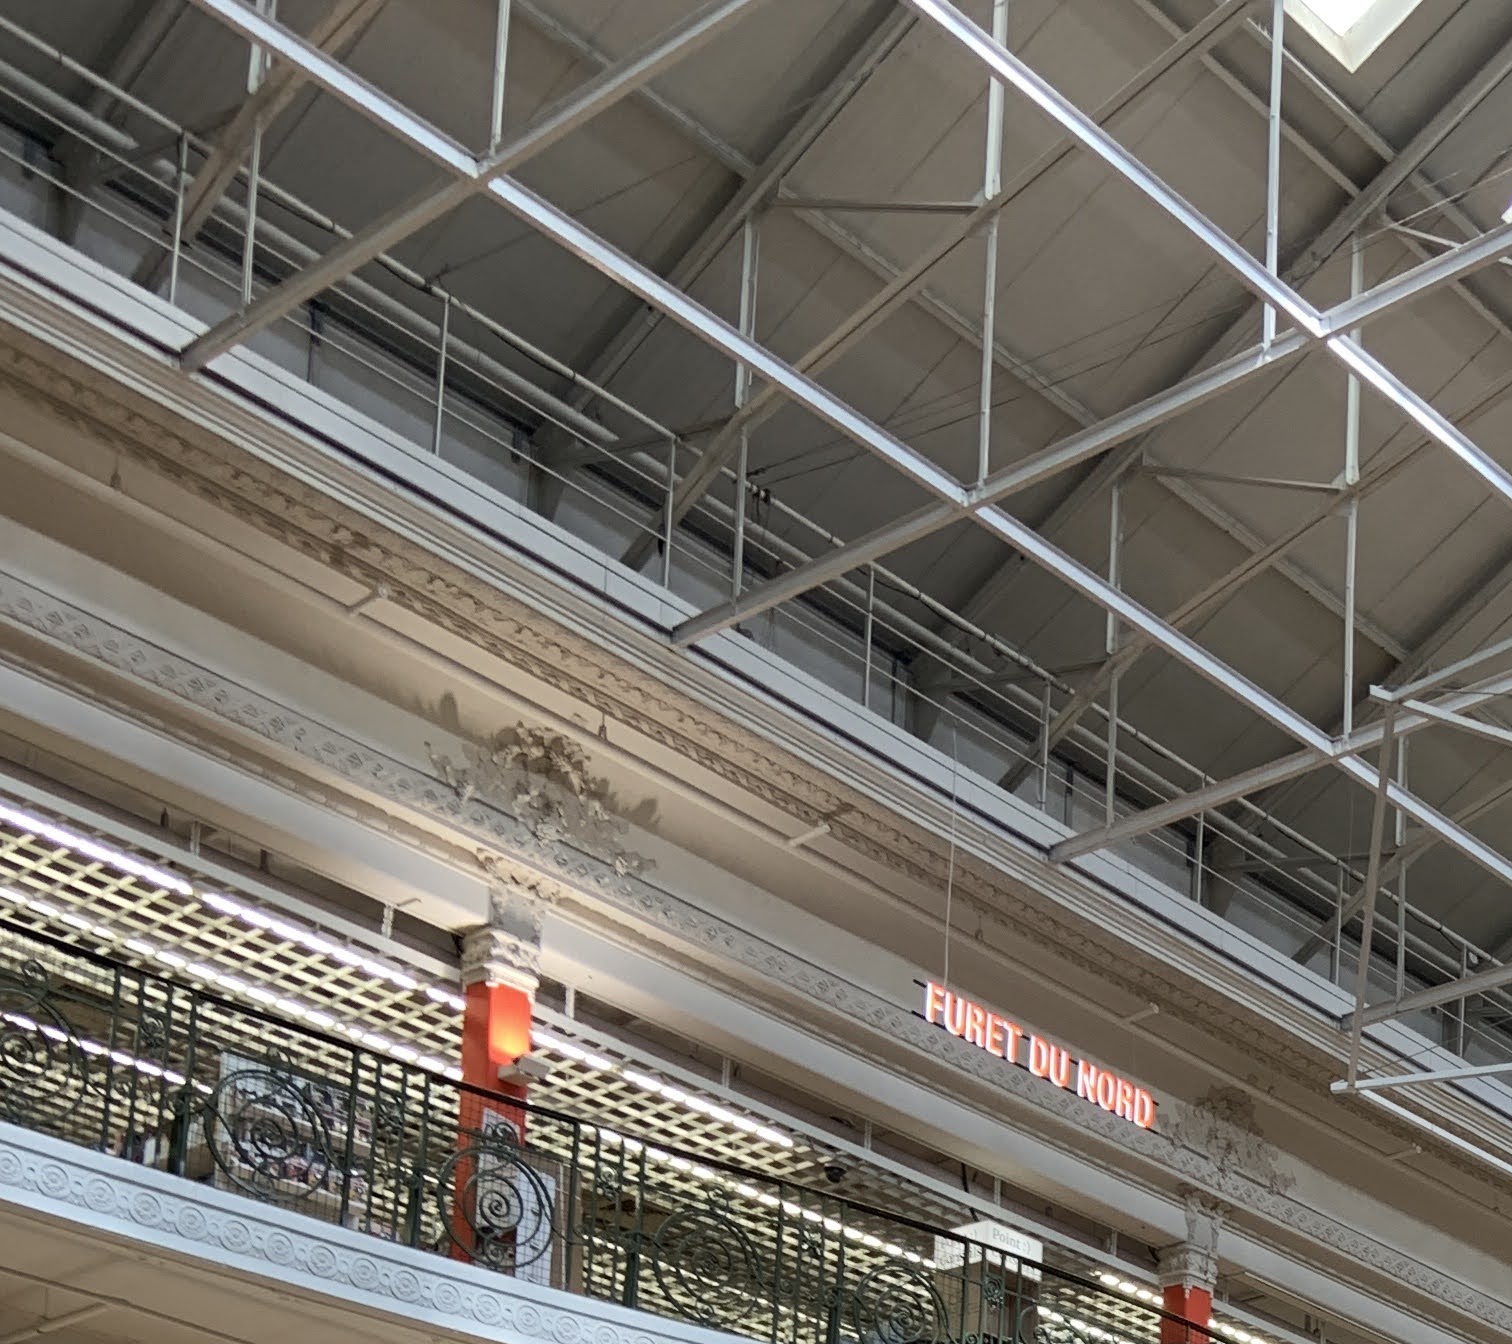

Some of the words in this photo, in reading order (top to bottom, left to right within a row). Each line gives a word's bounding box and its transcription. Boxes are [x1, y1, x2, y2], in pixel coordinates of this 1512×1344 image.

[925, 980, 1023, 1064] FURET
[1028, 1034, 1071, 1088] DU
[1076, 1059, 1155, 1129] NORD
[993, 1228, 1020, 1249] Point
